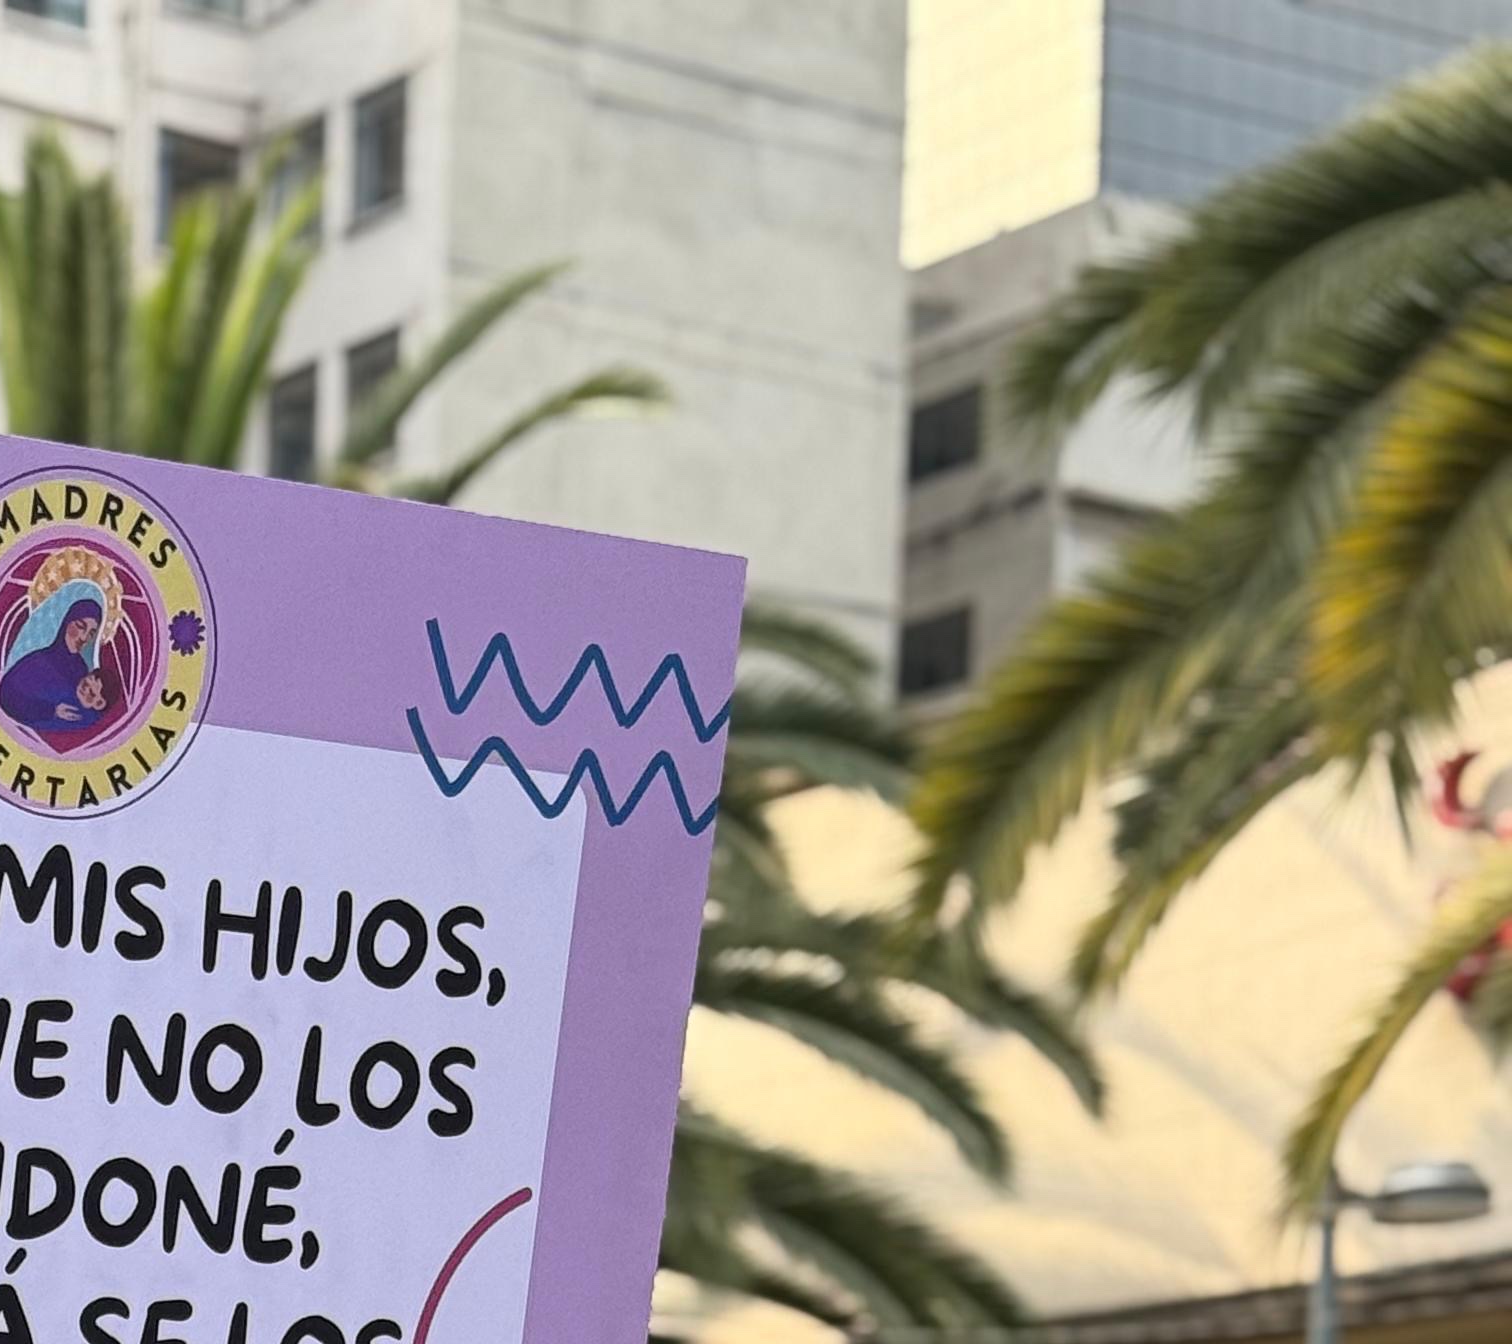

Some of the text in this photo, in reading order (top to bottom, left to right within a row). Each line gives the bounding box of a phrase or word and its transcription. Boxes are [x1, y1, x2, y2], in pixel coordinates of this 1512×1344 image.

[202, 878, 506, 1007] HIJOS,
[106, 1012, 263, 1115] NO
[295, 1025, 476, 1138] LOS
